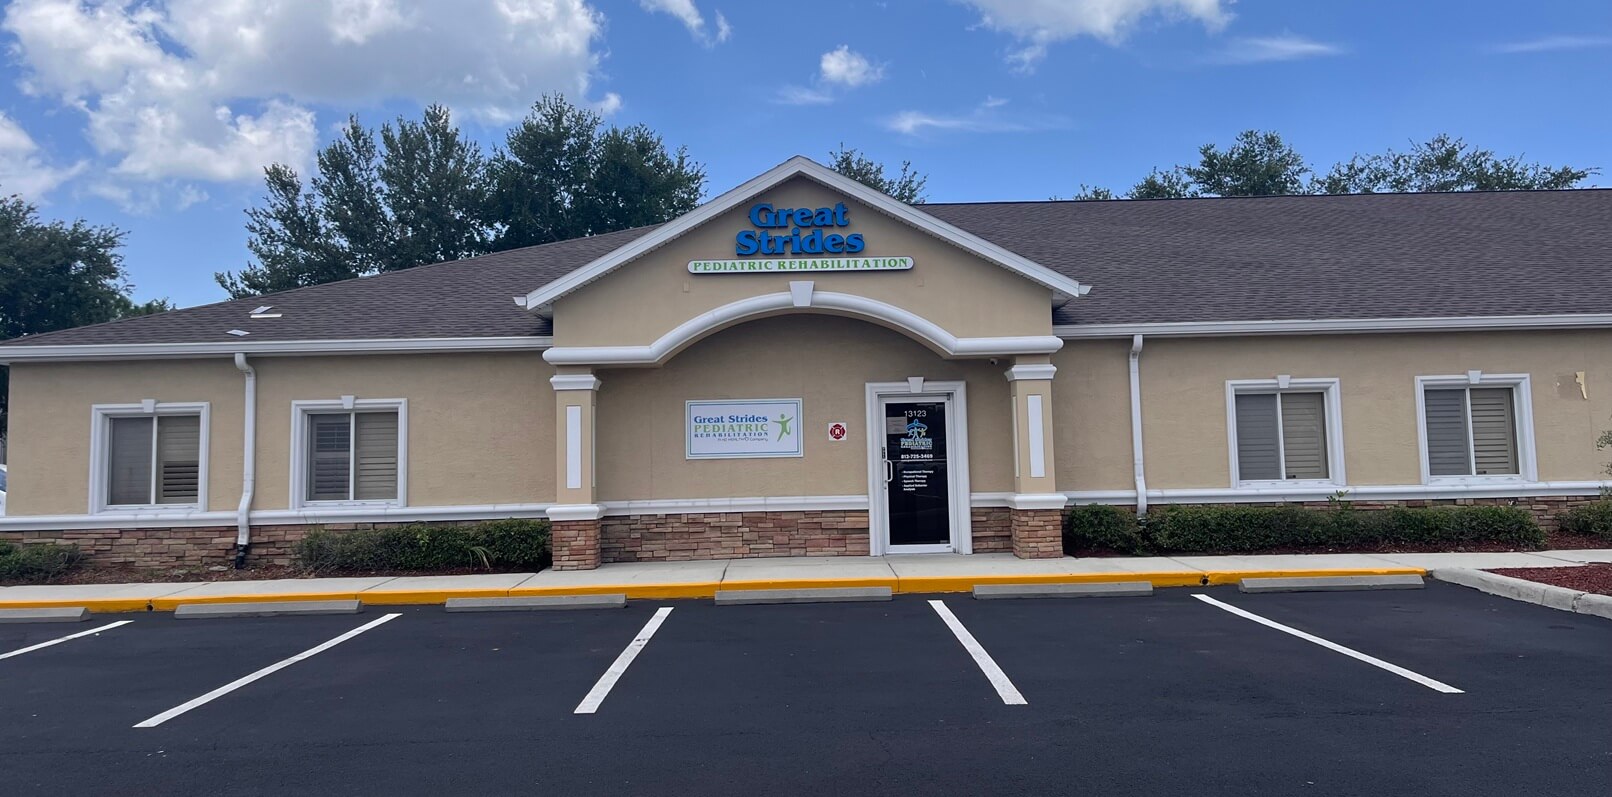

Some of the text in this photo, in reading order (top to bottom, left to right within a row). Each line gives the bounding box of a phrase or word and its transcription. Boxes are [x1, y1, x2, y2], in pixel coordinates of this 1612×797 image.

[748, 201, 850, 229] Great
[735, 227, 865, 257] Strides
[693, 258, 908, 272] PEDIATRIC REHABILITATION
[694, 414, 768, 424] Great Strides
[904, 410, 927, 418] 13123
[694, 423, 768, 433] PEDIATRIC
